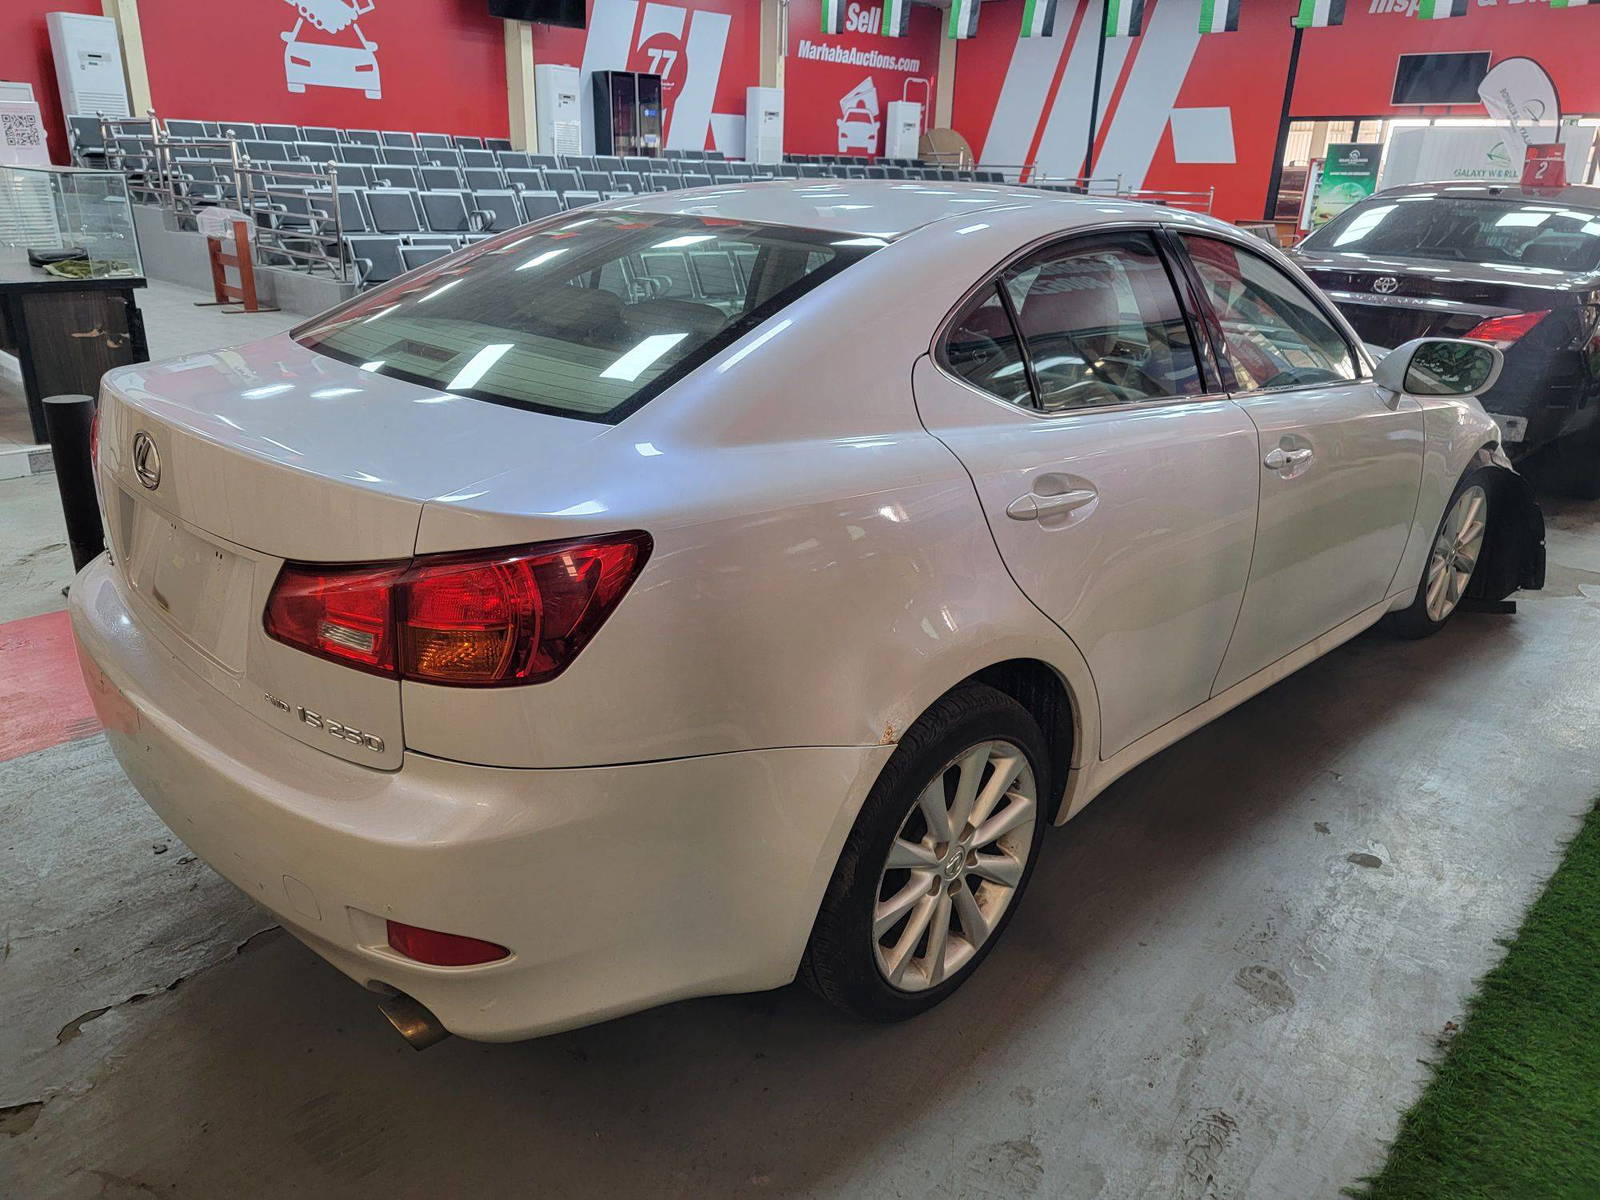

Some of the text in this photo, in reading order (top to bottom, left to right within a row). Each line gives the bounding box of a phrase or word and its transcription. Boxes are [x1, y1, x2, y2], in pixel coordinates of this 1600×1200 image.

[846, 2, 882, 35] Sell
[647, 48, 678, 80] 77
[798, 39, 921, 73] MarhabaAuctions.com
[1453, 168, 1486, 178] GALAXY
[1535, 160, 1549, 179] 2
[297, 705, 324, 730] IS
[326, 718, 385, 753] 250
